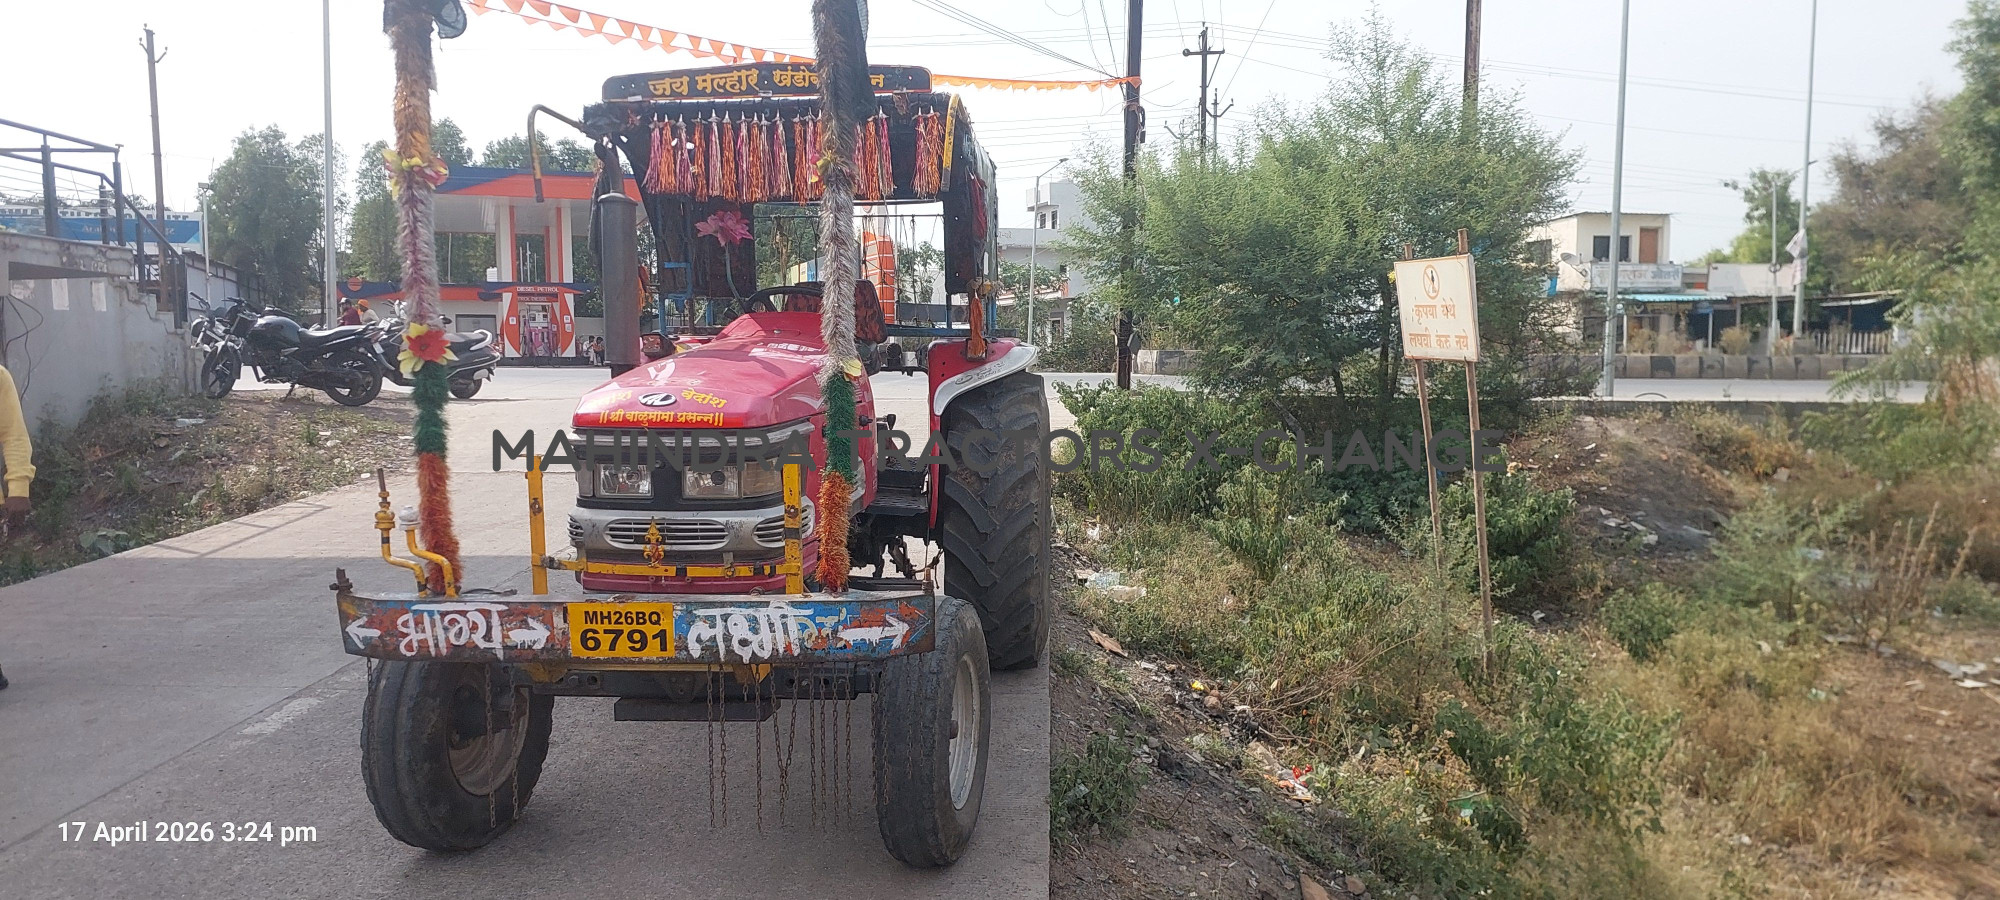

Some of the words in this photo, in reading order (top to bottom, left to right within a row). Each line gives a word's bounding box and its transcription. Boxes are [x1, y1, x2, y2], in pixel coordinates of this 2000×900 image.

[648, 76, 689, 96] जय
[695, 68, 760, 93] मल्हार
[772, 65, 820, 88] खंडोब
[584, 610, 662, 626] MH26BQ
[580, 628, 667, 652] 6791
